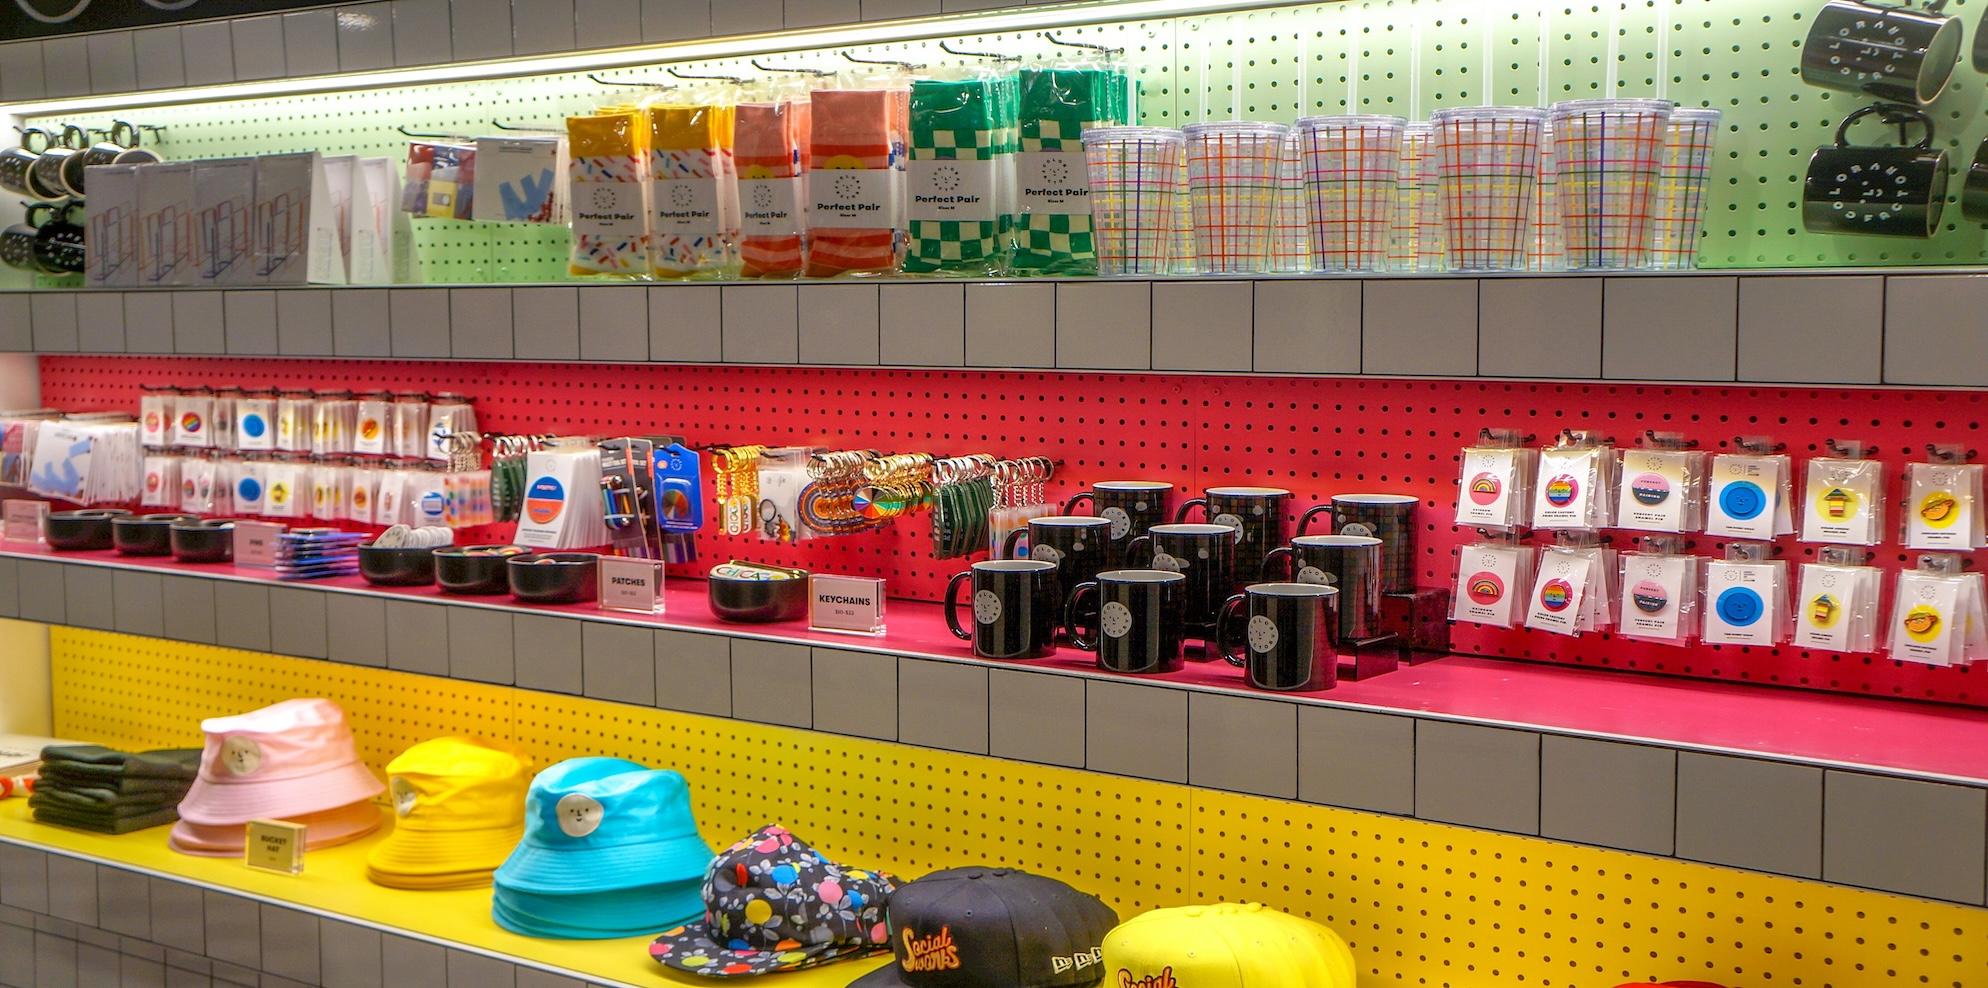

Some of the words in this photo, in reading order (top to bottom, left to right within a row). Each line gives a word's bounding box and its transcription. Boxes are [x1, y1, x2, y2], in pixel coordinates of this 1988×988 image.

[1066, 188, 1088, 196] Pair
[612, 577, 645, 586] PATCHES
[819, 595, 871, 606] KEYCHAINS
[261, 835, 287, 844] BUCKET
[902, 926, 952, 972] Social
